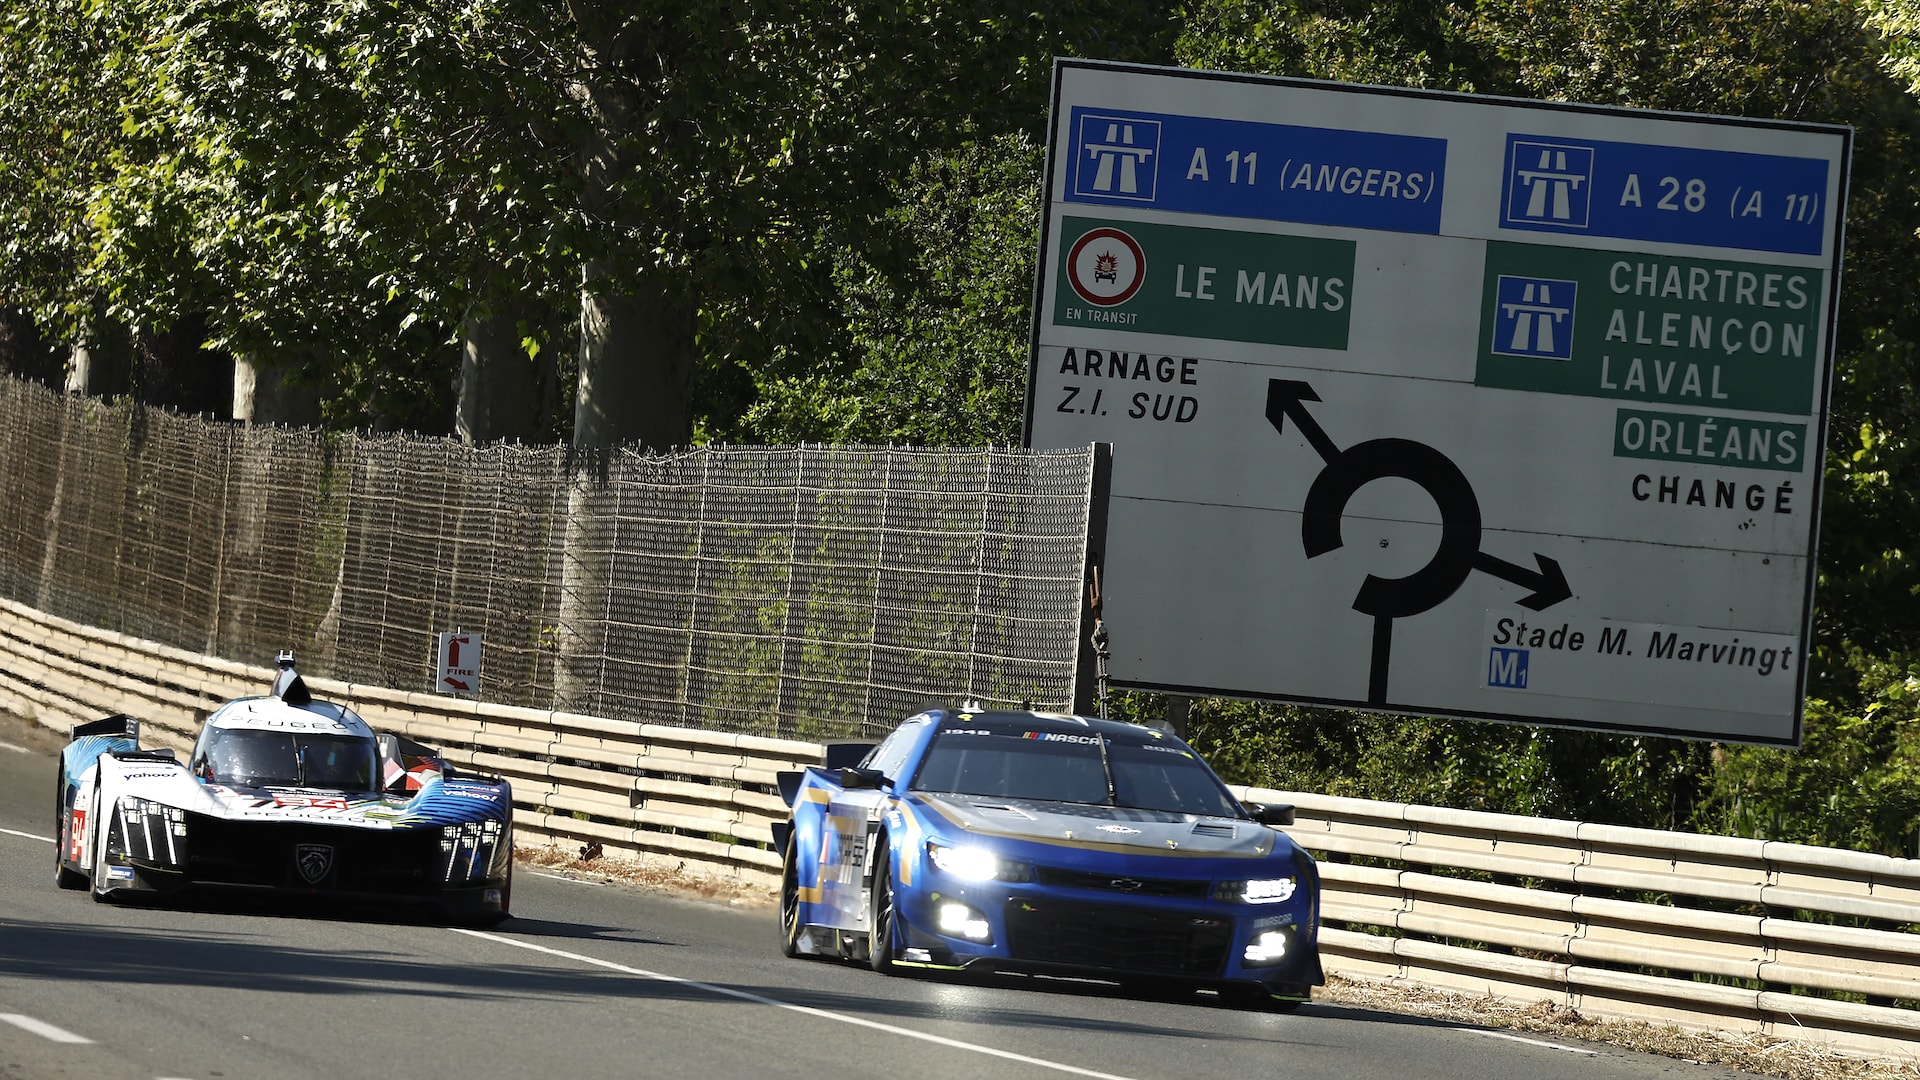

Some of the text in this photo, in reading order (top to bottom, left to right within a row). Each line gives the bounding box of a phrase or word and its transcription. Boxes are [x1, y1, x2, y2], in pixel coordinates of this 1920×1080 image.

[1186, 147, 1436, 202] A 11 (ANGERS)
[1620, 173, 1819, 225] A 28 (A 11)
[1175, 264, 1345, 312] LE MANS
[1609, 260, 1808, 310] CHARTRES
[1066, 307, 1138, 325] EN TRANSIT
[1604, 308, 1805, 358] ALENÇON
[1059, 348, 1198, 385] ARNAGE
[1600, 355, 1729, 399] LAVAL
[1057, 386, 1198, 424] Z.I. SUD
[1621, 417, 1797, 465] ORLÉANS
[1632, 474, 1794, 514] CHANGÉ
[1493, 617, 1792, 676] Stade M. Marvingt
[231, 715, 360, 730] PEUGEOT
[124, 772, 178, 781] yahoo!
[443, 790, 498, 802] yahoo!
